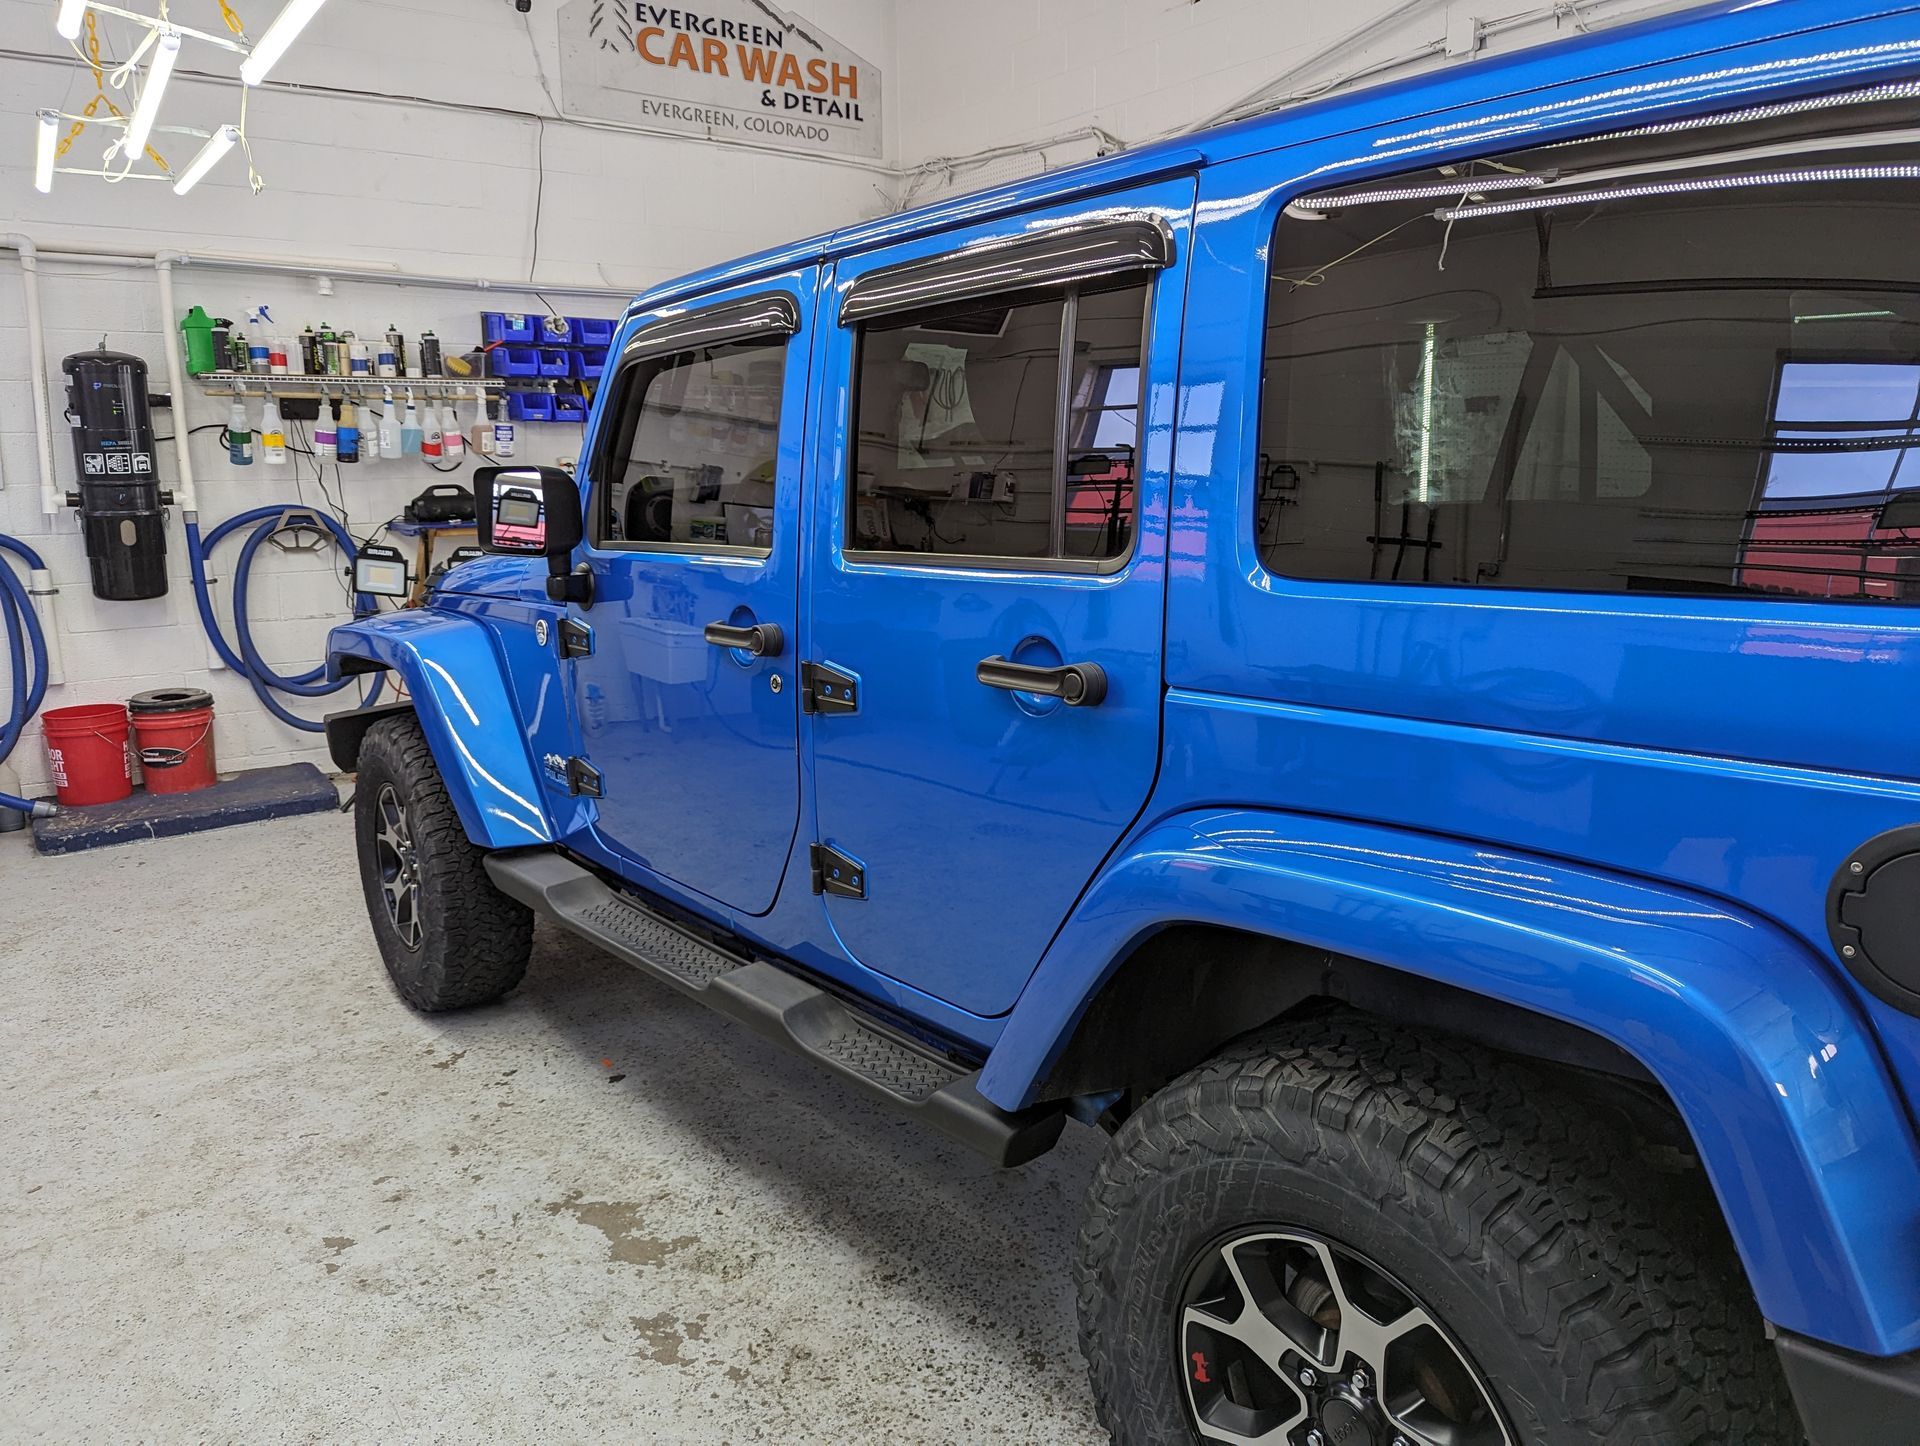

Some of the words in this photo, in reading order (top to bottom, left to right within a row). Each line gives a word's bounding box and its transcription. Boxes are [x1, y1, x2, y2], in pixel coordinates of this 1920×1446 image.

[635, 2, 783, 48] EVERGREEN
[635, 26, 729, 77] CAR
[737, 44, 858, 99] WASH
[641, 99, 739, 130] EVERGREEN,
[743, 117, 829, 142] COLORADO
[760, 89, 776, 108] &
[784, 92, 864, 122] DETAIL
